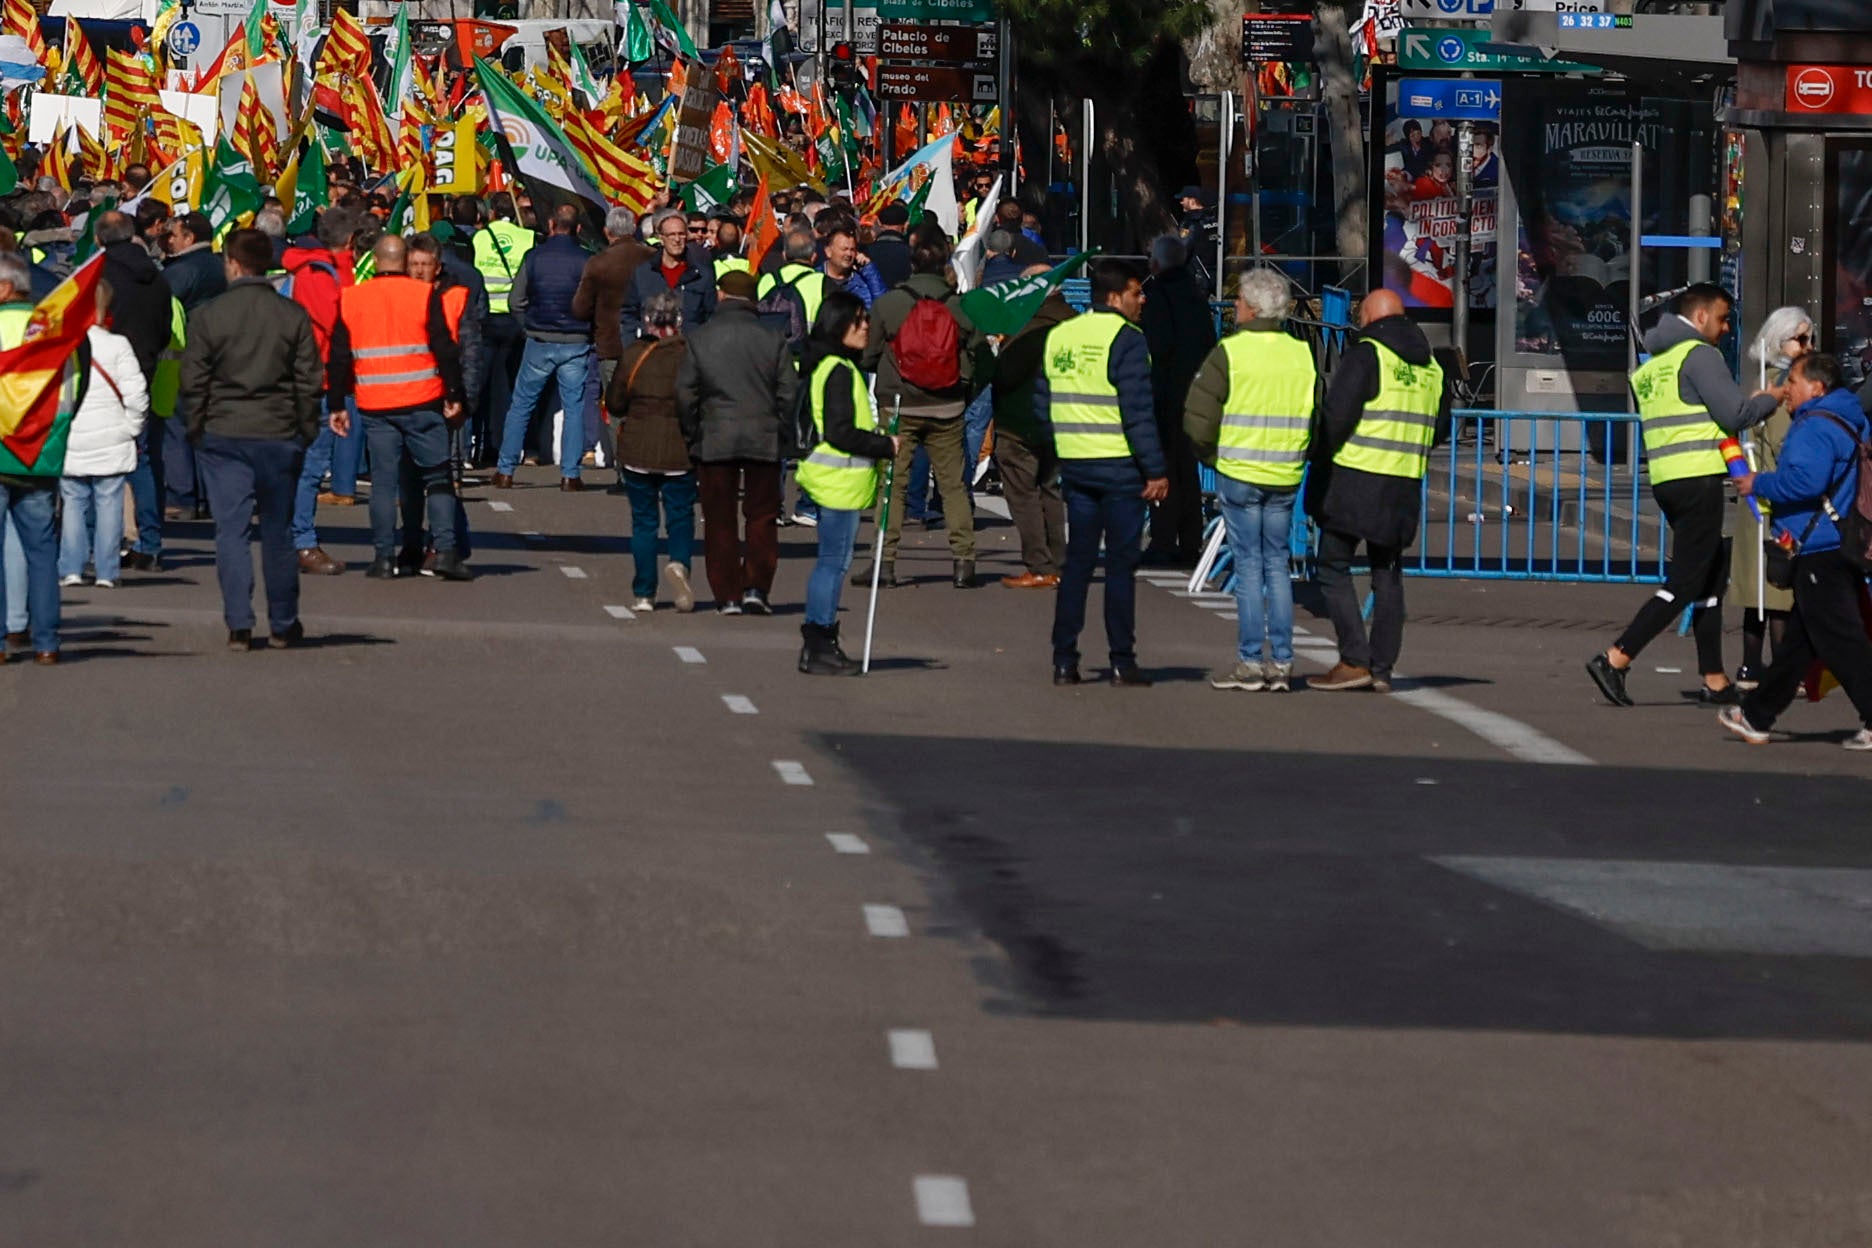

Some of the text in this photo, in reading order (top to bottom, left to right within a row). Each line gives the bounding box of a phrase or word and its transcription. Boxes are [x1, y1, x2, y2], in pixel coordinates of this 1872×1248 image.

[1562, 15, 1575, 27] 26
[1580, 15, 1593, 27] 32
[1599, 16, 1612, 27] 37
[882, 30, 928, 43] Palacio
[934, 32, 950, 43] de
[882, 43, 928, 55] Cibeles
[1467, 51, 1490, 63] Sta.
[881, 71, 929, 82] museo del
[881, 83, 917, 96] Prado
[1459, 92, 1481, 106] A-1
[1587, 310, 1621, 323] 600€
